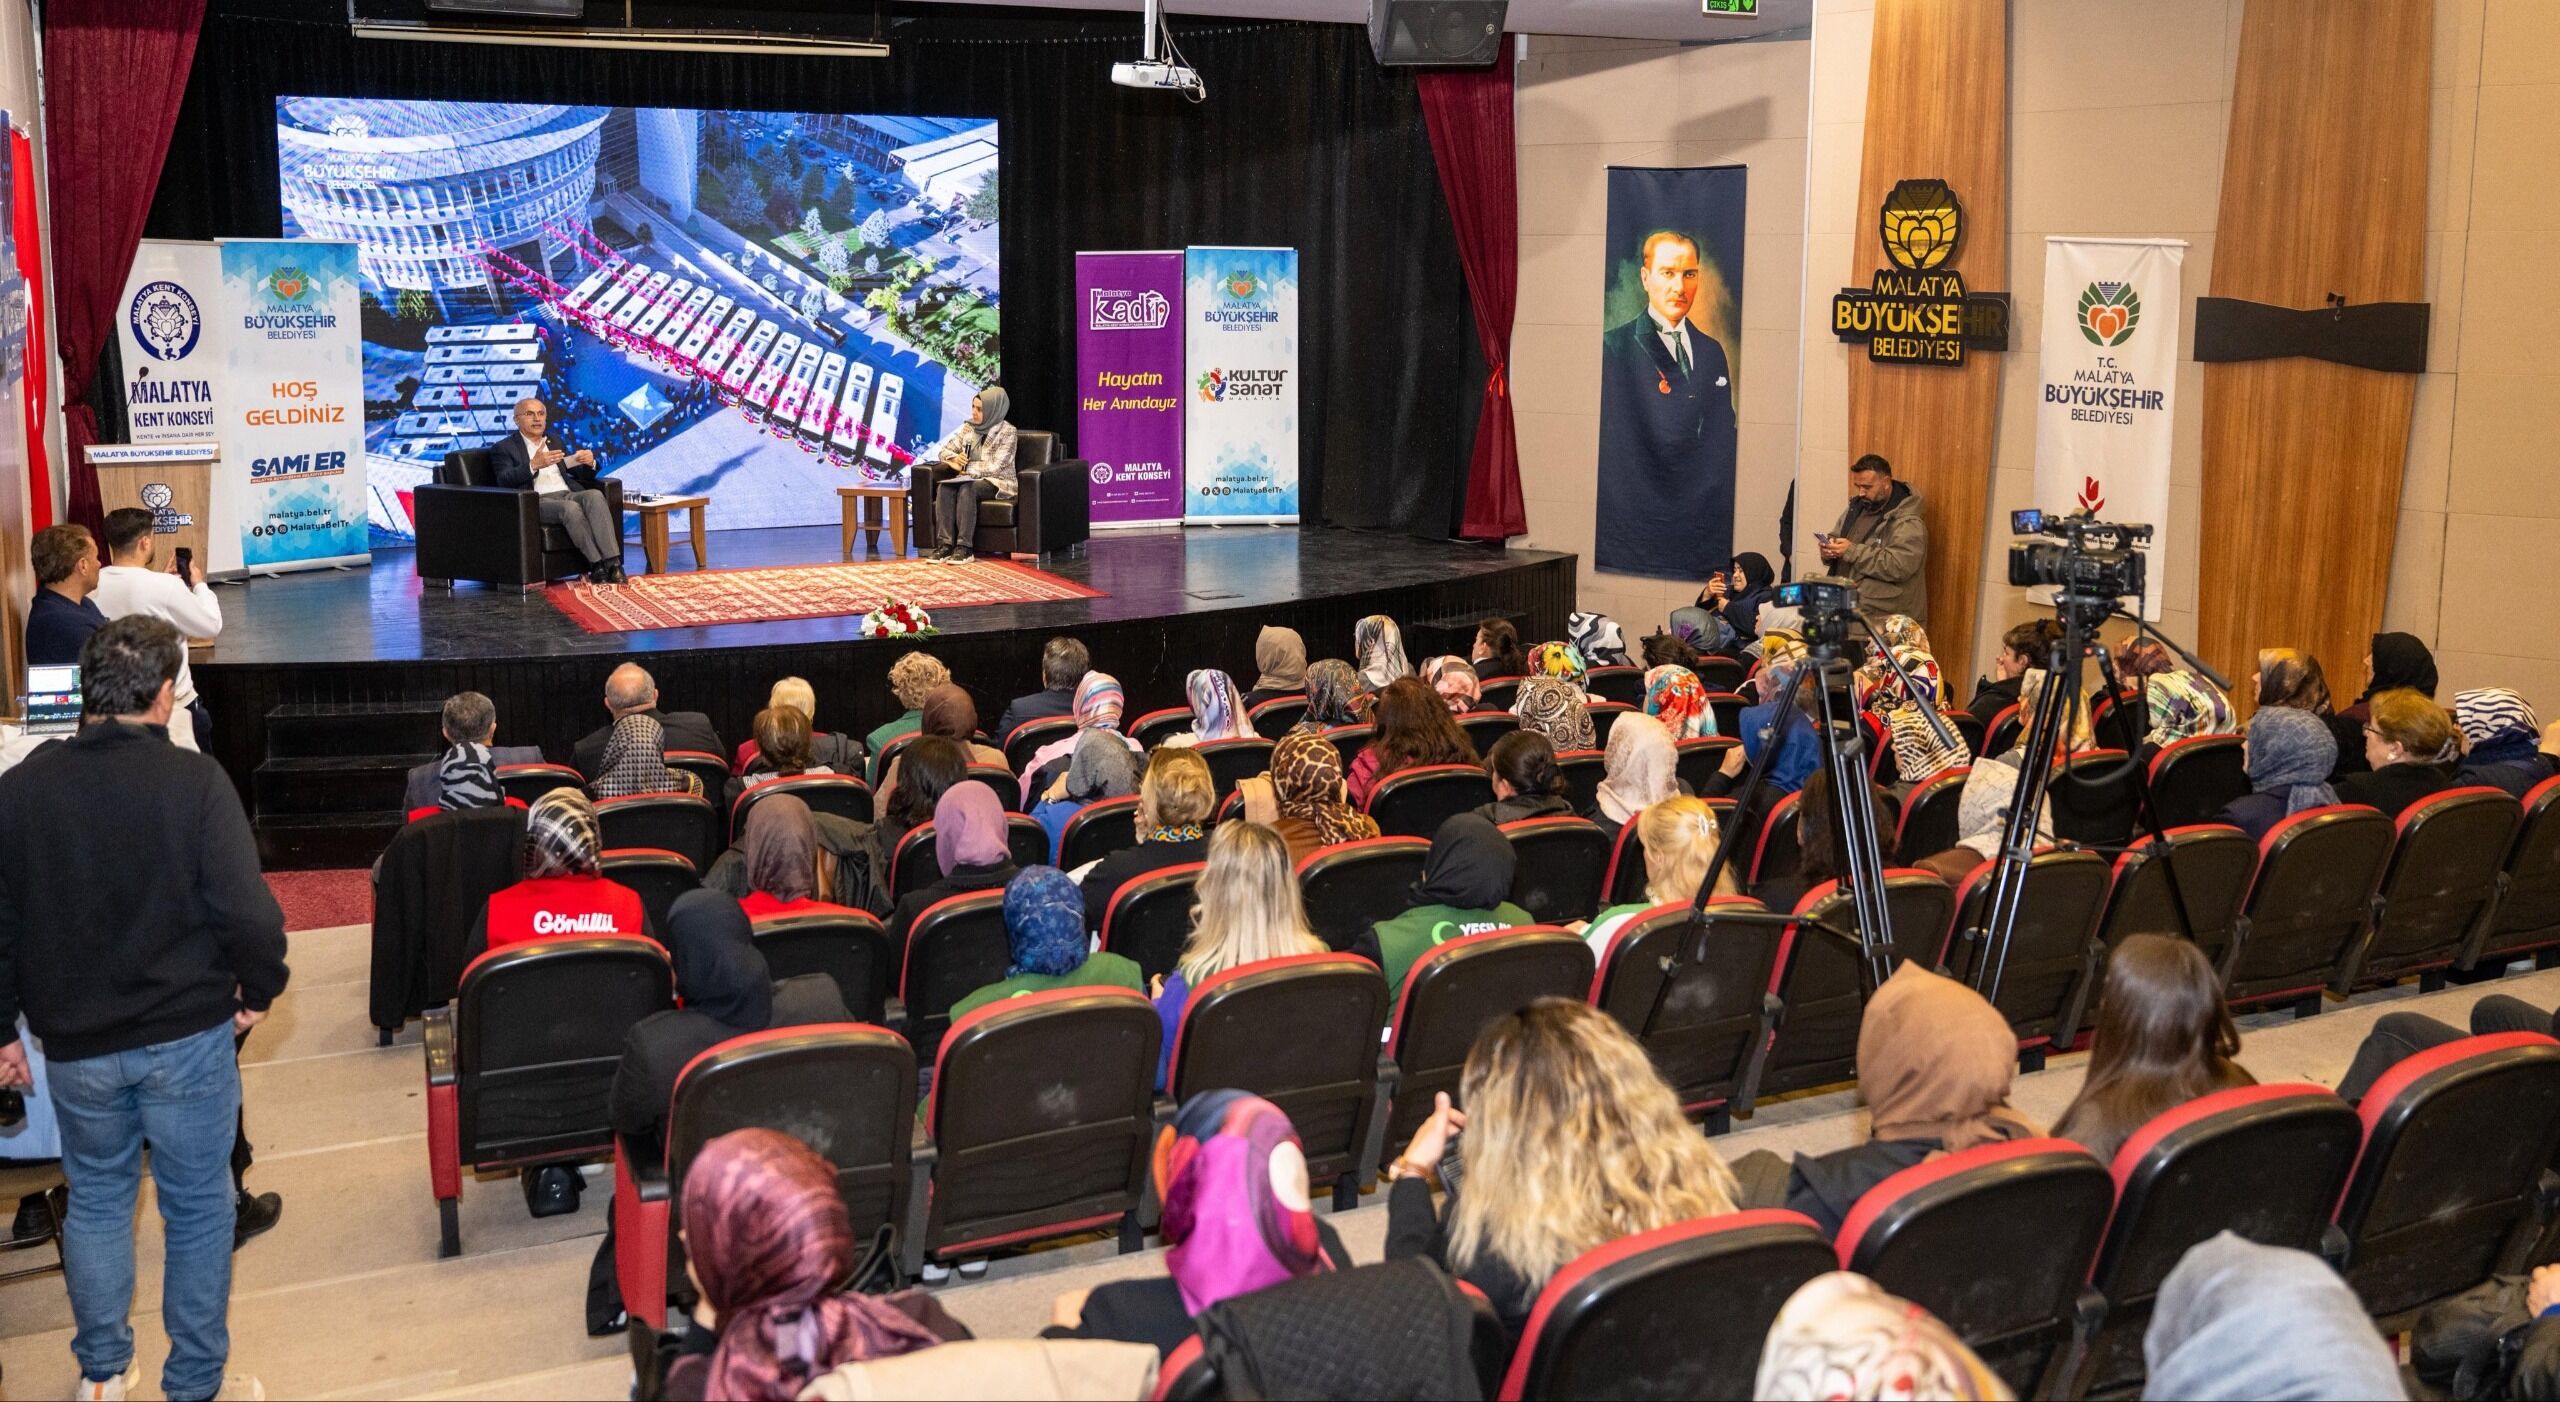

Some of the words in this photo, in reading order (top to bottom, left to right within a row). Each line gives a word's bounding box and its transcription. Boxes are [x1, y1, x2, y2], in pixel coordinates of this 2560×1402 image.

[1876, 275, 1962, 297] MALATYA
[133, 288, 152, 325] MALATYA
[152, 284, 176, 292] KENT
[266, 304, 315, 313] MALATYA
[1222, 301, 1261, 310] MALATYA
[2097, 357, 2118, 368] T.C.
[1098, 371, 1163, 391] Hayatın
[2074, 369, 2135, 385] MALATYA
[130, 380, 212, 404] MALATYA
[272, 381, 318, 401] HOŞ
[1083, 398, 1107, 411] Her
[1110, 396, 1177, 412] Anındayız
[134, 412, 165, 427] KENT
[167, 407, 214, 426] KONSEYİ
[246, 403, 345, 426] GELDİNİZ
[93, 449, 129, 458] MALATYA
[314, 451, 346, 471] ER
[1124, 463, 1162, 472] MALATYA
[1115, 473, 1137, 481] KENT
[1138, 469, 1171, 481] KONSEYİ
[1215, 474, 1269, 484] malatya.bel.tr
[1232, 486, 1283, 496] MalatyaBelTr
[268, 508, 332, 519] malatya.bel.tr
[290, 520, 349, 532] MalatyaBelTr
